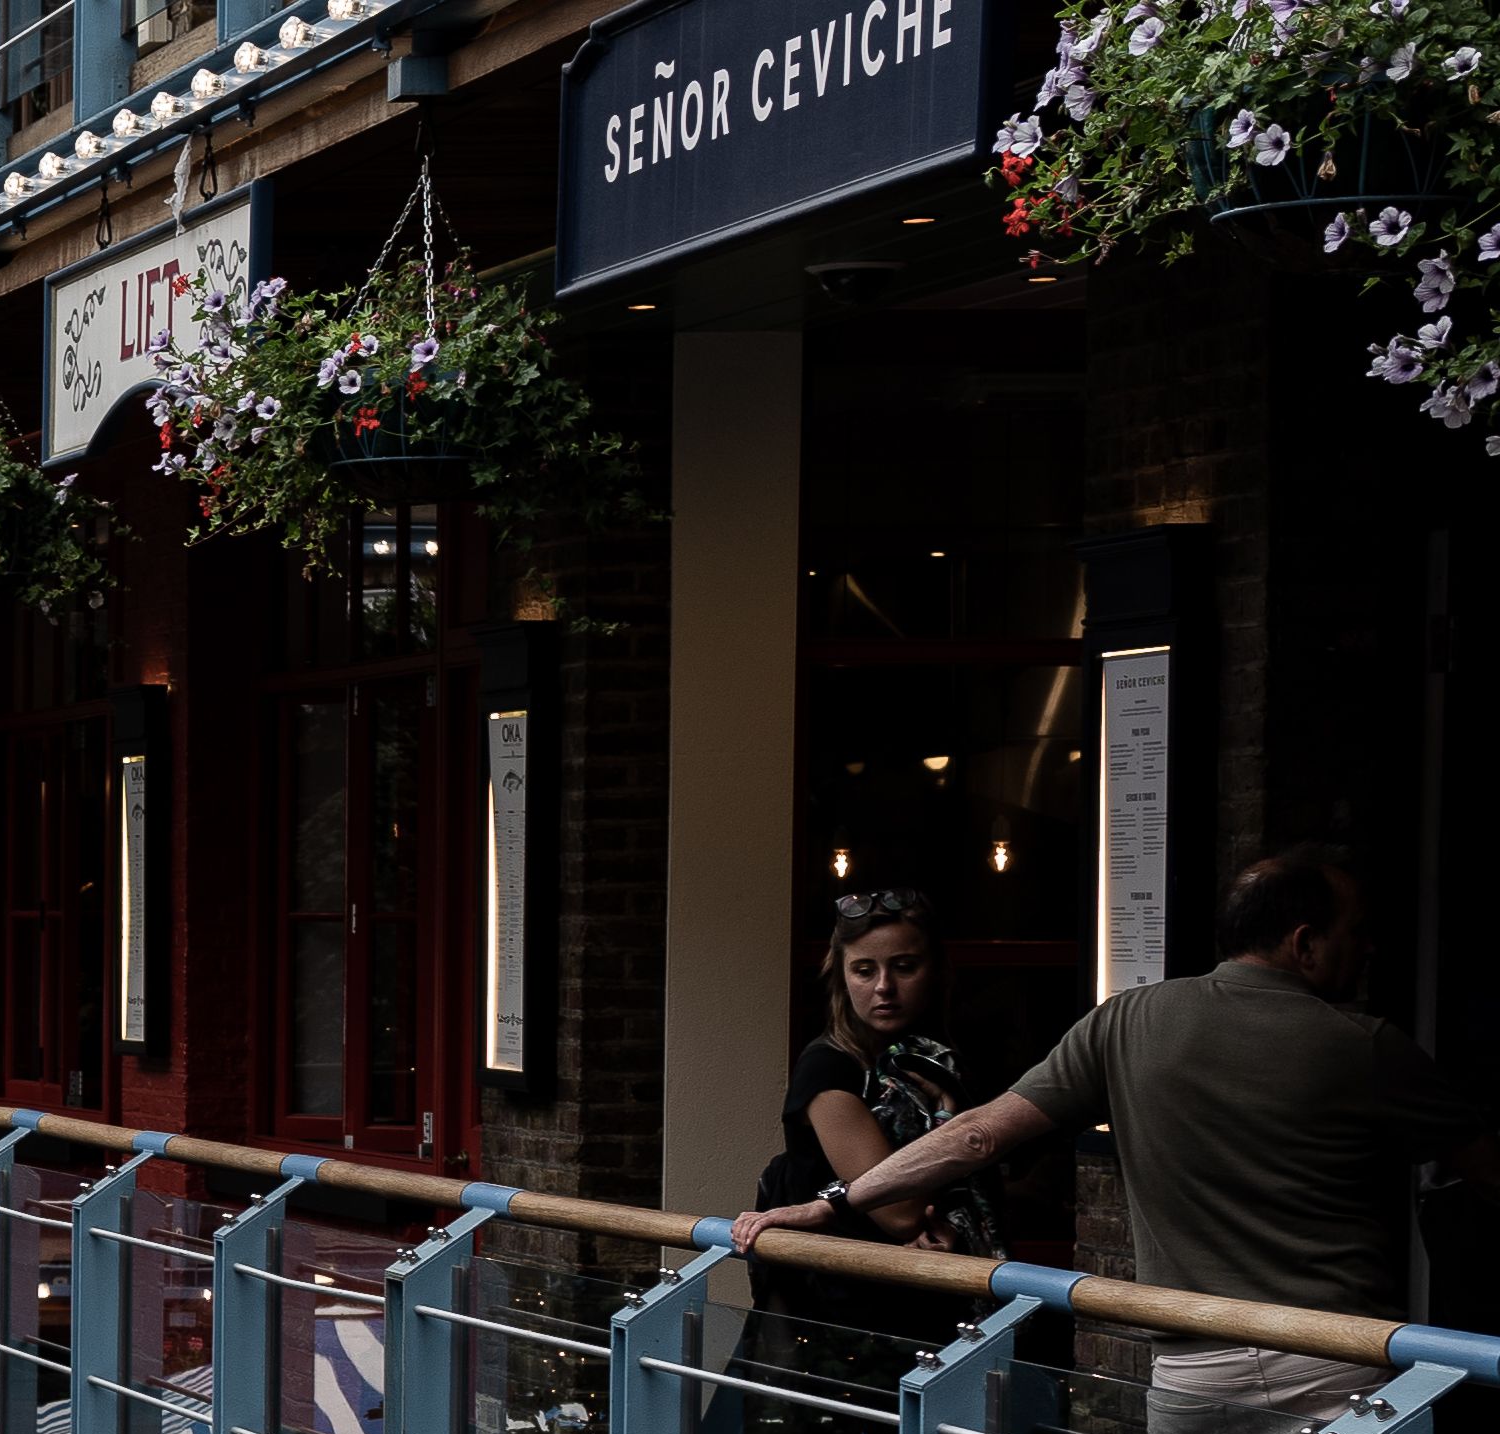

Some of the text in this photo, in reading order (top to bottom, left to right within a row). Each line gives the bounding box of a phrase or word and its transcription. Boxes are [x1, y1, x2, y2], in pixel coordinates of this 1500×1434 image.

[604, 0, 952, 183] SEÑOR CEVICHE
[120, 258, 181, 362] LIFT
